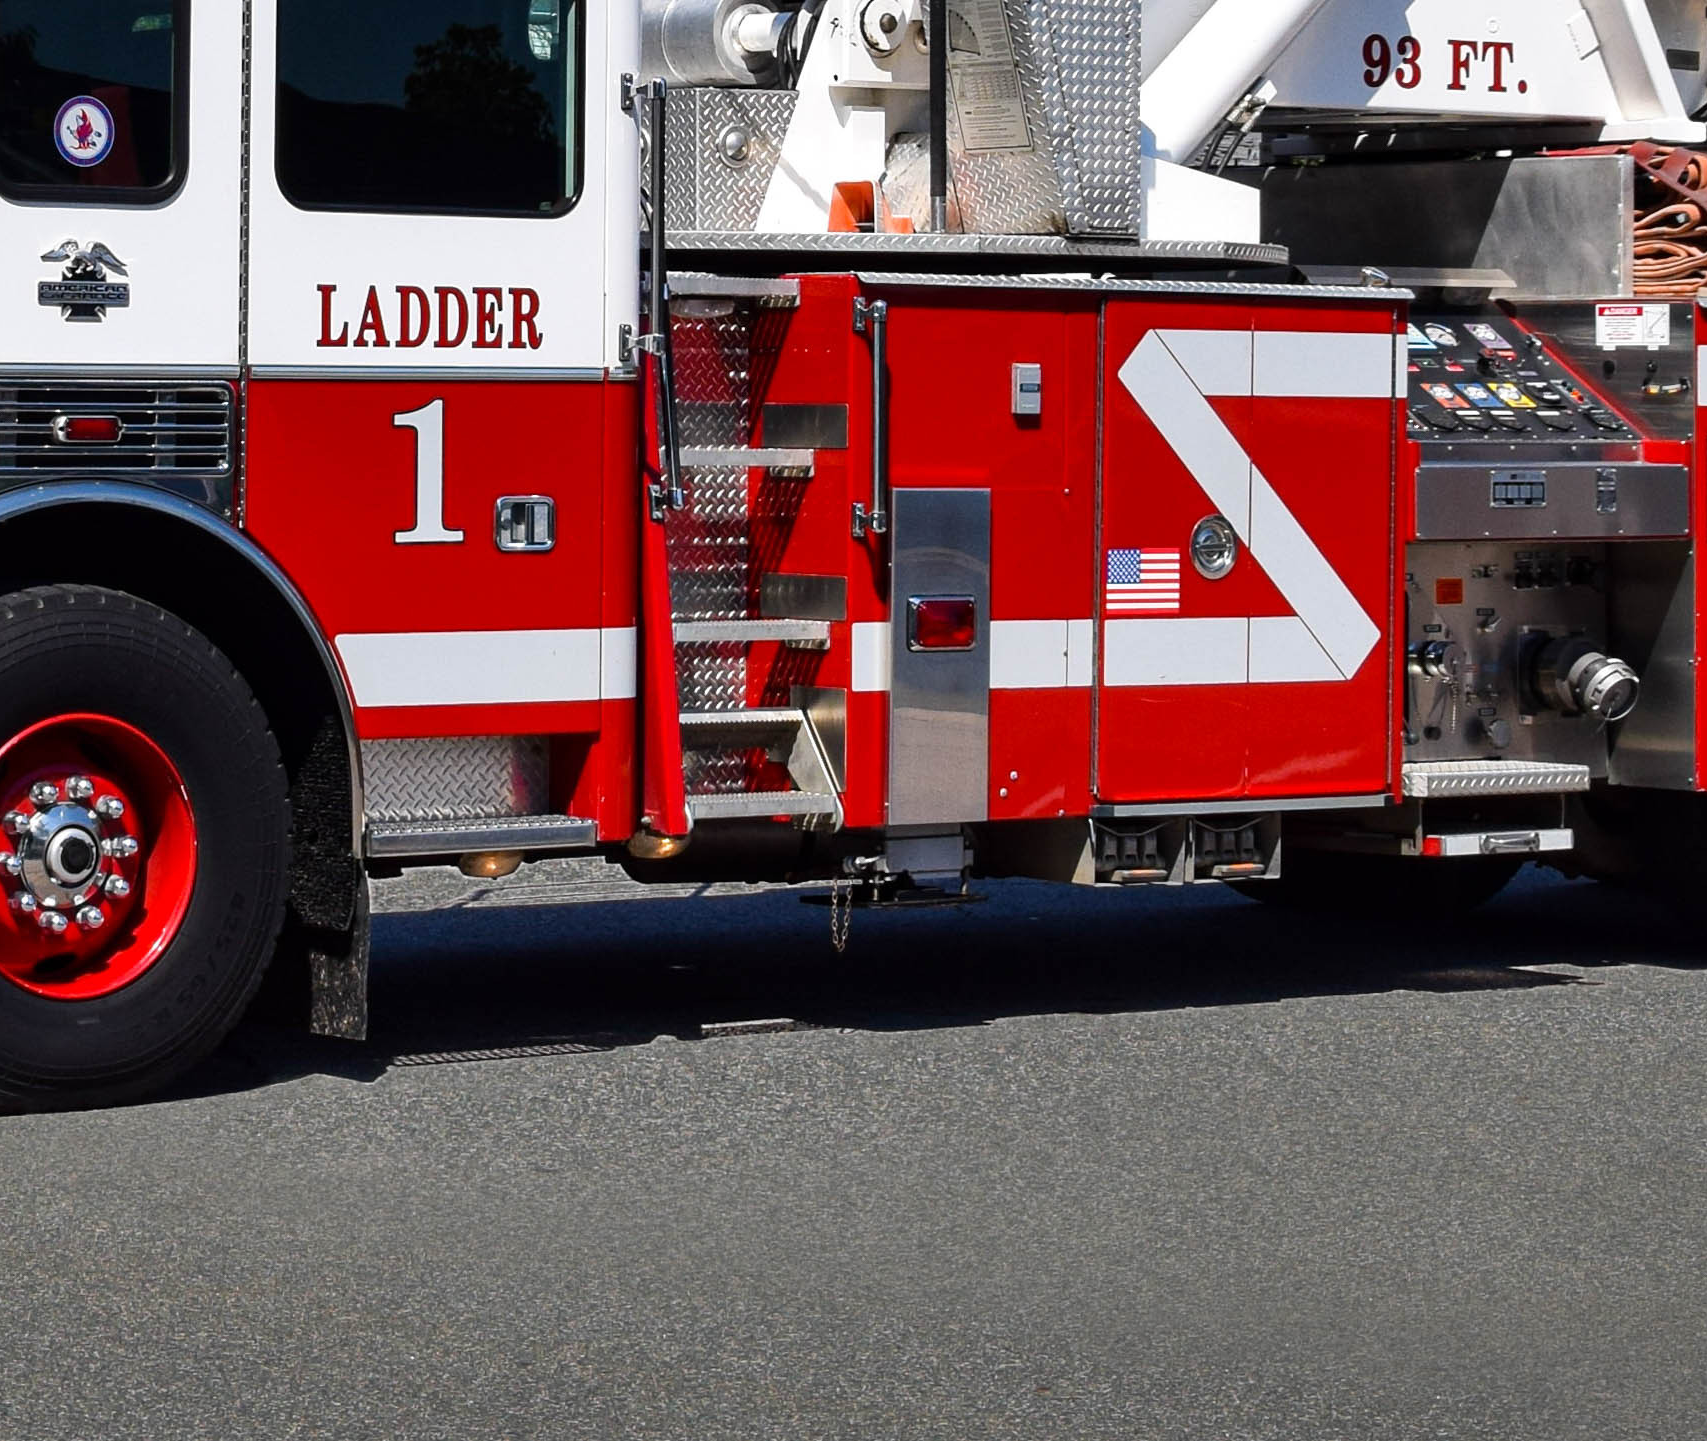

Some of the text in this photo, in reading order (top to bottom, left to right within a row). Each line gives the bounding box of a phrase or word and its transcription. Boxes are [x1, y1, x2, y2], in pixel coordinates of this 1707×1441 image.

[1362, 33, 1528, 94] 93 FT.
[316, 284, 543, 350] LADDER
[393, 397, 465, 544] 1
